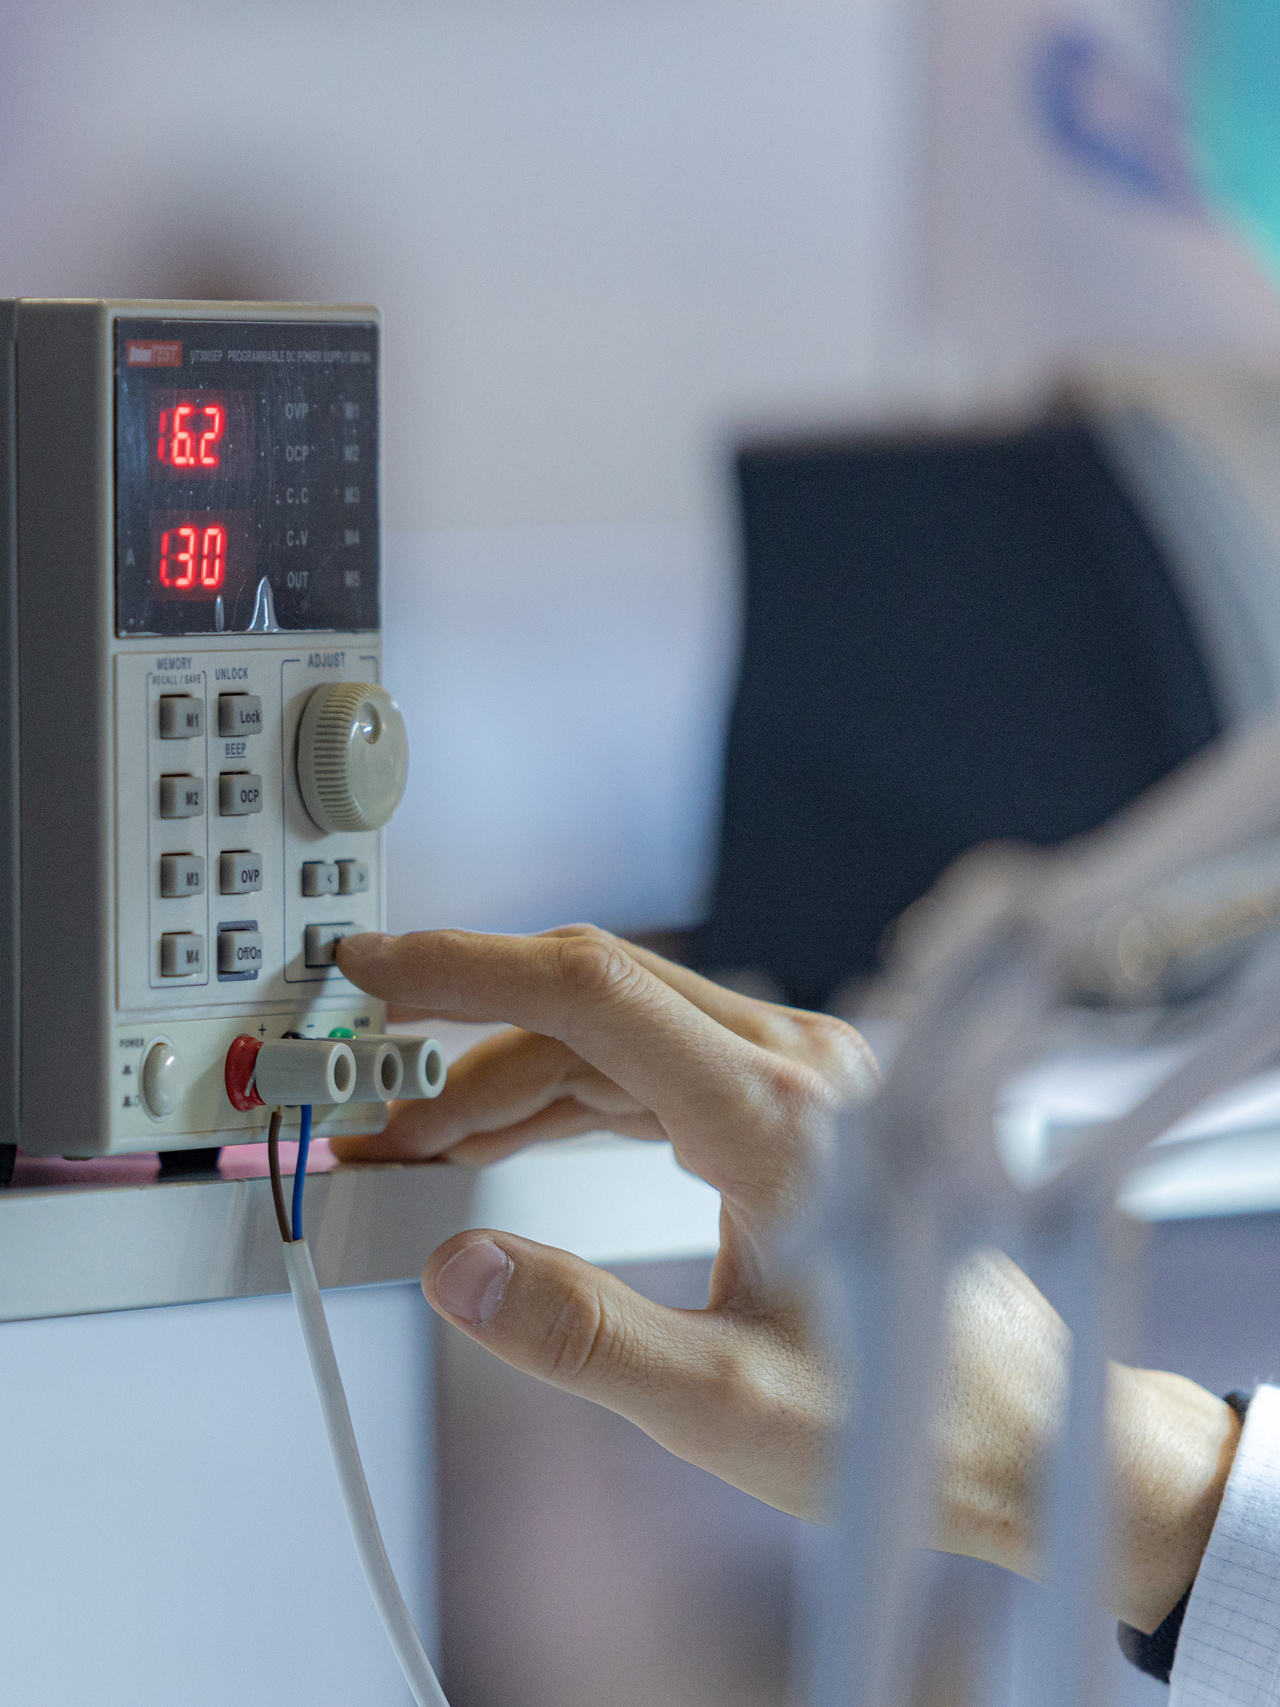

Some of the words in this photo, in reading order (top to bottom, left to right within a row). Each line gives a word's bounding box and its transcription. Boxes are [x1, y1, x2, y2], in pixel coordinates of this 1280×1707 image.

[227, 349, 285, 362] PROGRAMMABLE
[286, 350, 297, 362] DC
[285, 402, 309, 419] OVP
[285, 445, 309, 462] OCP
[286, 571, 309, 588] OUT
[156, 657, 192, 670] MEMORY
[307, 652, 346, 668] ADJUST
[152, 675, 177, 685] RECALL
[185, 674, 202, 684] SAVE
[215, 667, 249, 680] UNLOCK
[186, 713, 199, 727] M1
[240, 710, 261, 724] Lock
[225, 743, 247, 755] BEEP
[186, 791, 199, 805] M2
[240, 789, 260, 803] OCP
[186, 872, 199, 886] M3
[241, 869, 260, 883] OVP
[186, 950, 199, 964] M4
